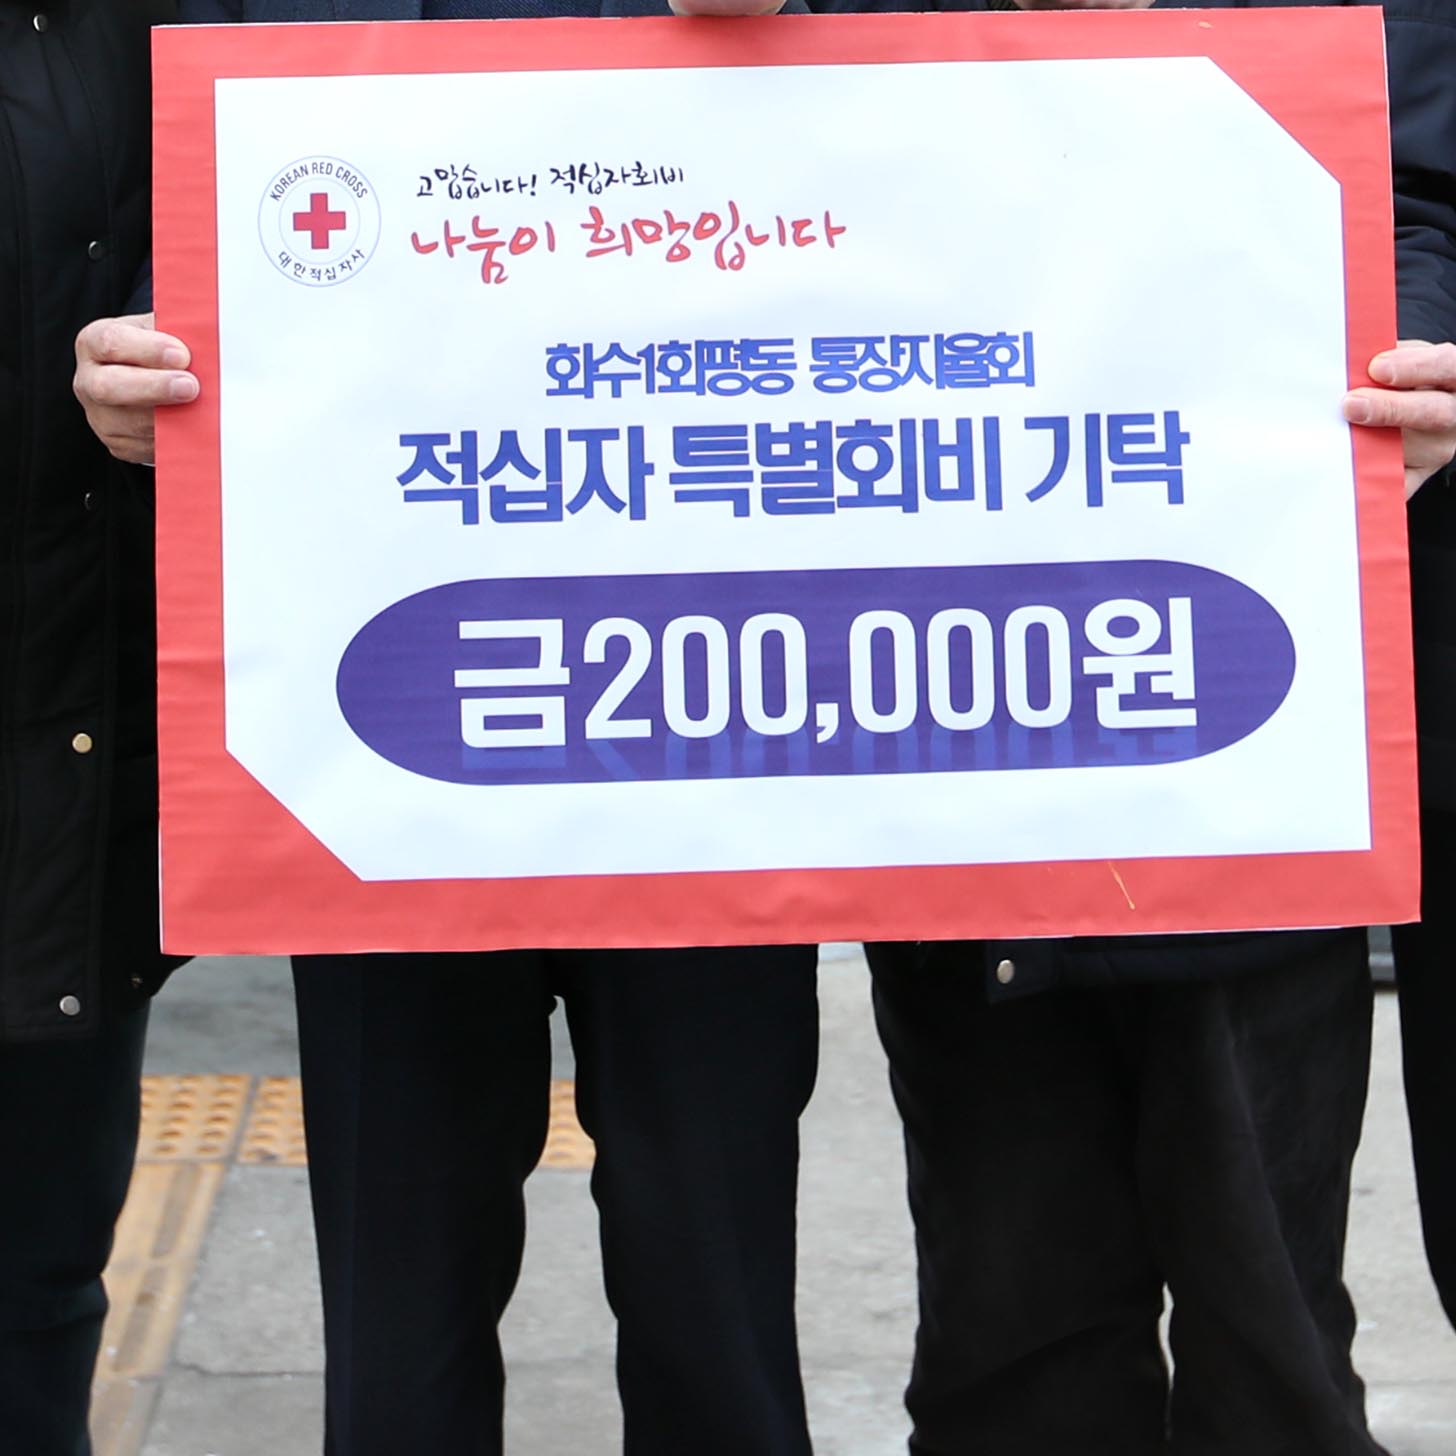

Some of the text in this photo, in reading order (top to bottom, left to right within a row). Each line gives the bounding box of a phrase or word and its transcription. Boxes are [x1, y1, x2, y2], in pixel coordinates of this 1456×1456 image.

[270, 161, 368, 201] KOREAN RED CROSS
[416, 160, 685, 200] 고맙습니다! 적십자회비
[278, 248, 365, 281] 대한적십자사
[411, 200, 846, 284] 나눔이 희망입니다
[396, 410, 1191, 526] 적십자 특별회비 기탁
[454, 597, 1197, 748] 금200,000원
